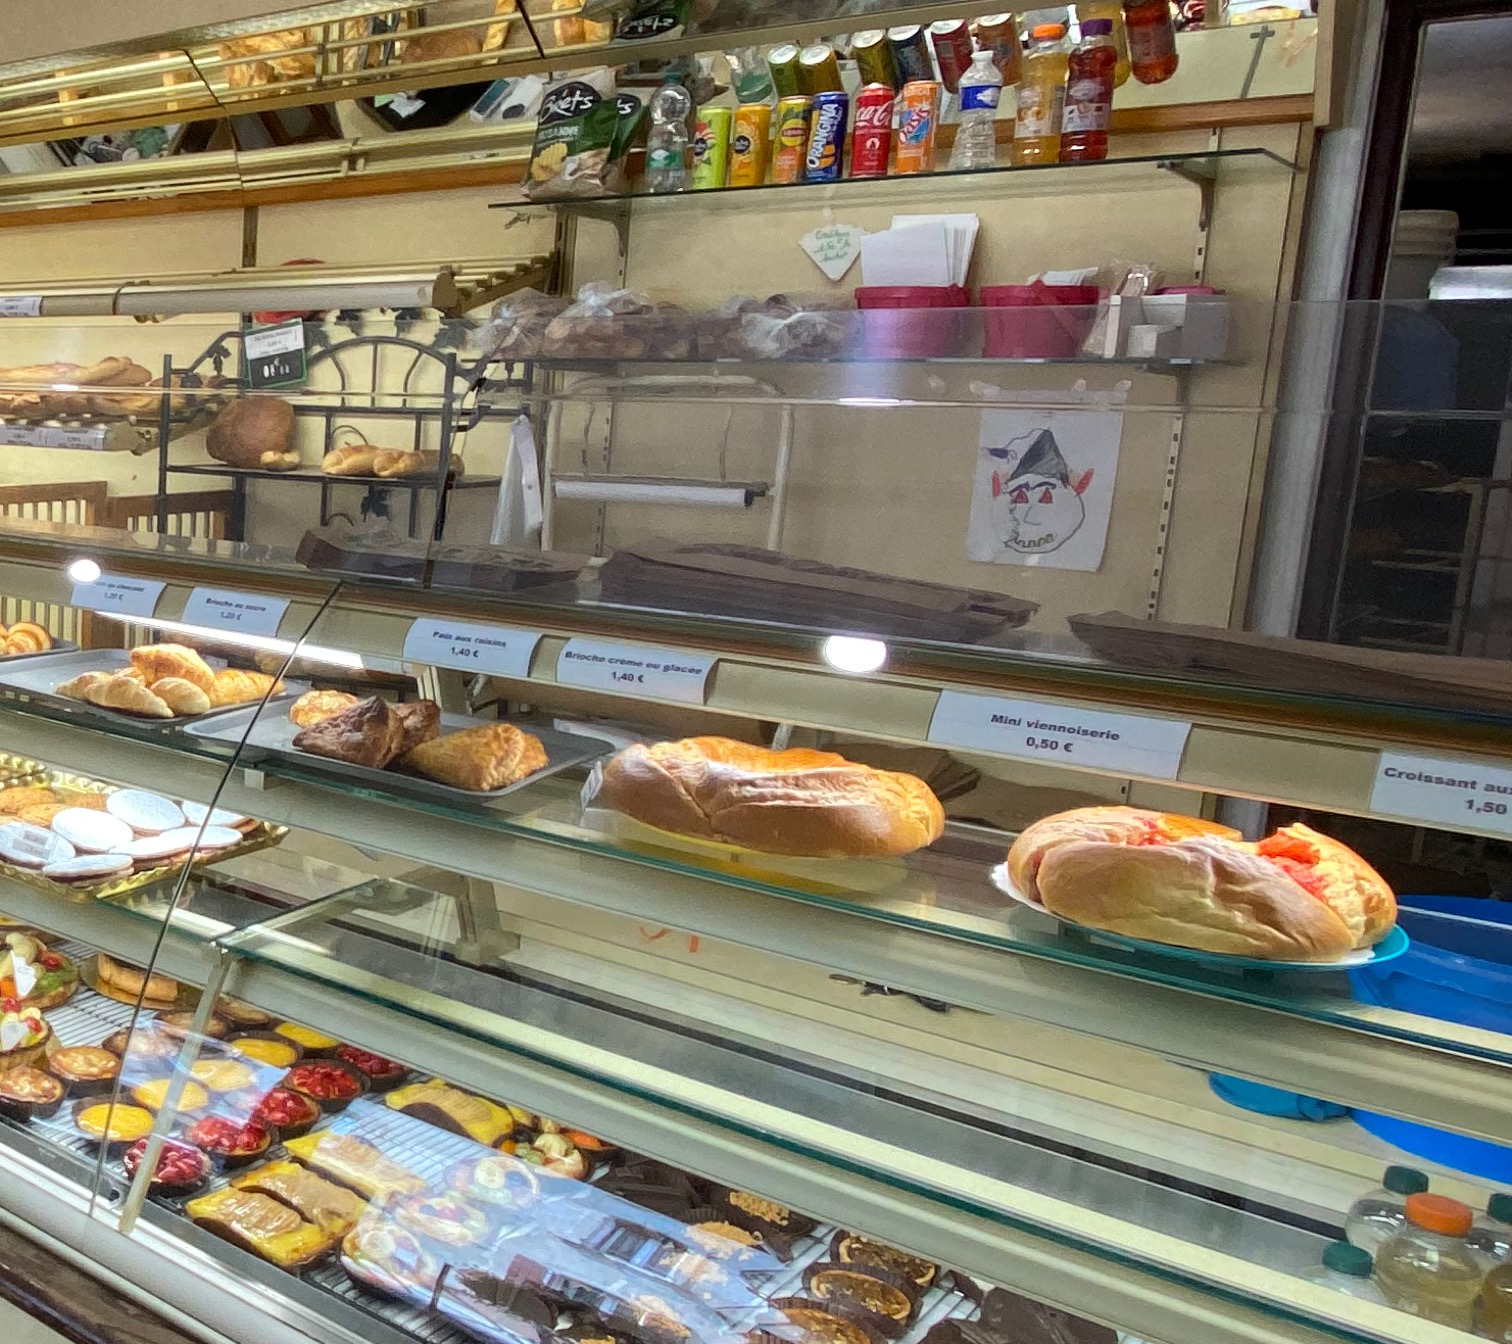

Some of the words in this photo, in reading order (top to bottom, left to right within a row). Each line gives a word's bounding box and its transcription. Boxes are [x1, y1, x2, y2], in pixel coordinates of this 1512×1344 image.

[807, 104, 839, 168] ORANGINA
[433, 631, 453, 640] Pain
[455, 635, 472, 643] aux
[474, 637, 507, 648] raisins
[451, 646, 471, 657] 1,40
[473, 649, 480, 658] €
[565, 651, 606, 664] Brioche
[646, 662, 660, 670] ou
[611, 671, 634, 682] 1,40
[637, 674, 645, 683] €
[990, 714, 1022, 727] Mini
[1027, 720, 1121, 742] viennoiserie
[1026, 736, 1059, 751] 0,50
[1063, 742, 1074, 753] €
[1384, 767, 1478, 790] Croissant
[1465, 798, 1508, 815] 1,50
